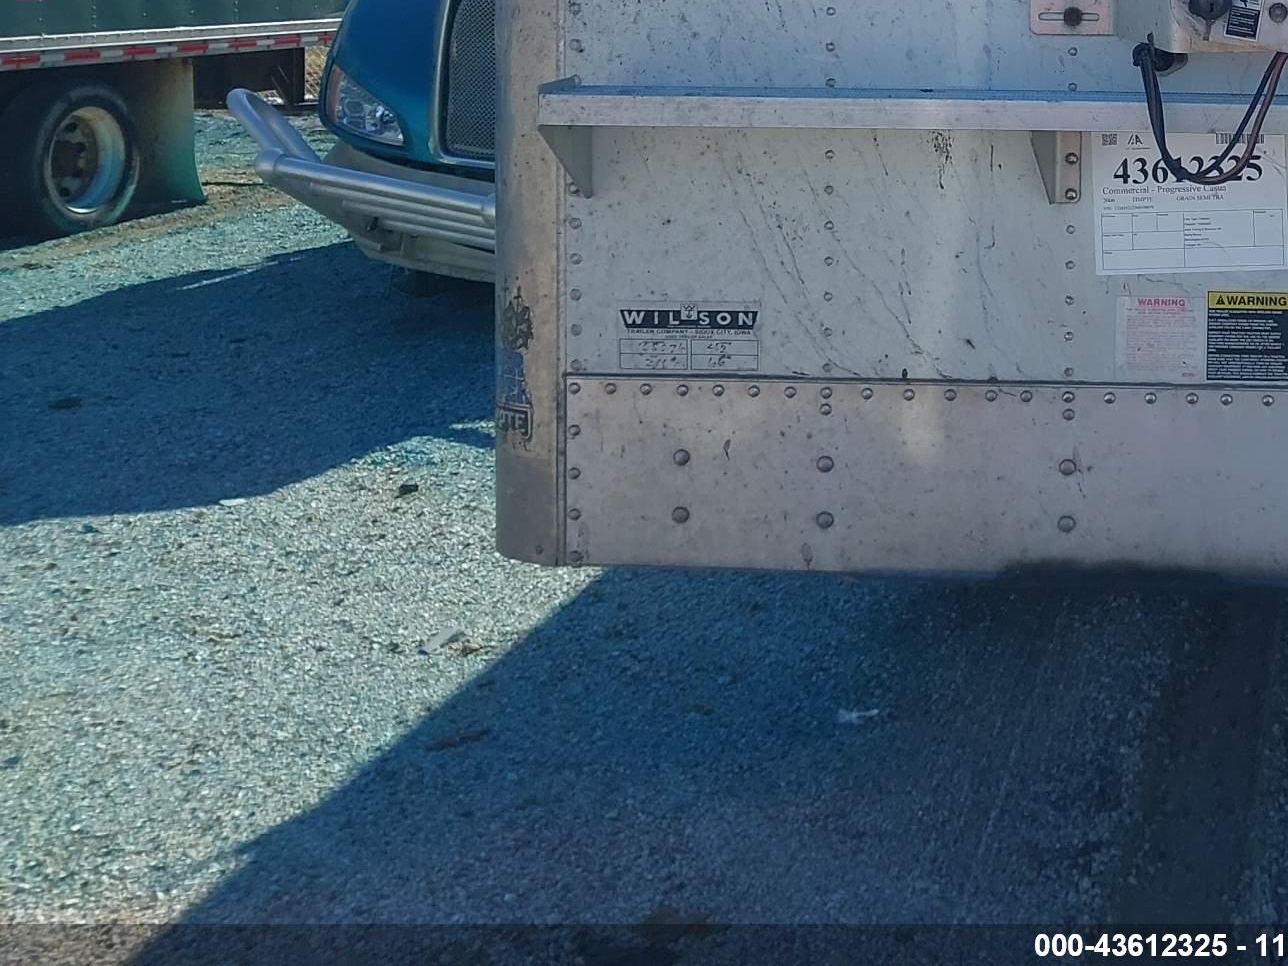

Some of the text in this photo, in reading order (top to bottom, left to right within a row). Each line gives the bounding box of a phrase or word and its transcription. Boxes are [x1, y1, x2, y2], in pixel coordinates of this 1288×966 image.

[1102, 186, 1150, 196] Commercial
[1157, 185, 1201, 195] Progressive
[1136, 297, 1186, 307] WARNING
[1227, 294, 1288, 306] WARNING
[623, 310, 754, 326] WILSON
